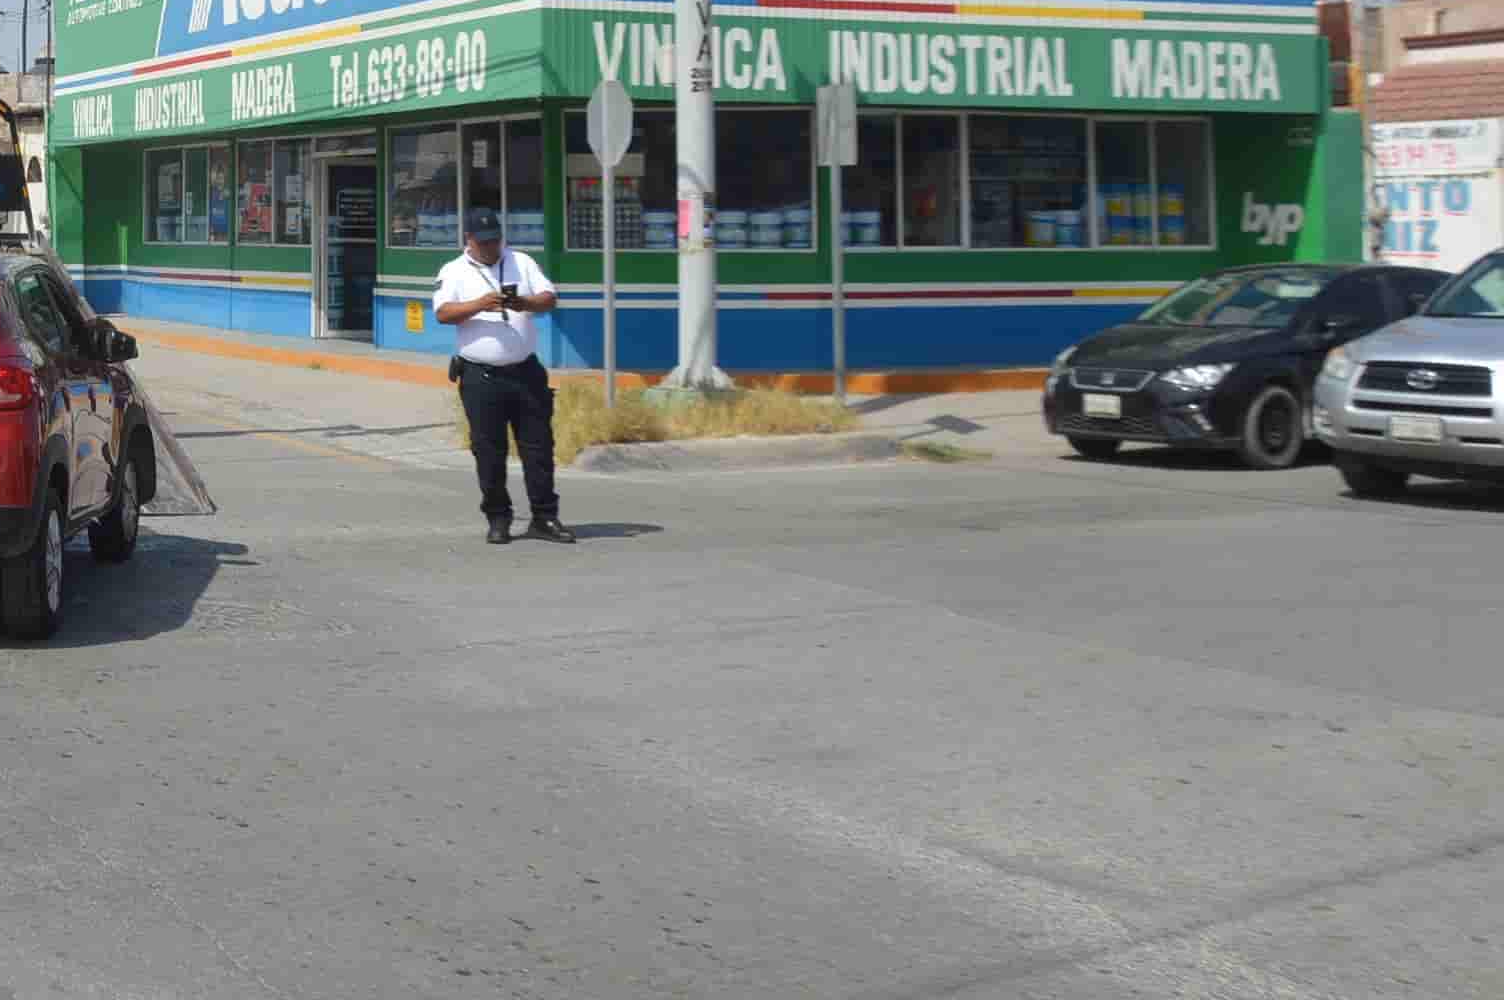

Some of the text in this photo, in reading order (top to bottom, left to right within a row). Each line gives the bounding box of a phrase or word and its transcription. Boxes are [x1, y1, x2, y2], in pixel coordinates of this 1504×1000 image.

[592, 21, 1281, 101] VINICA INDUSTRIAL MADERA
[134, 80, 205, 131] INDUSTRIAL
[231, 62, 295, 121] MADERA
[1241, 191, 1305, 246] byp
